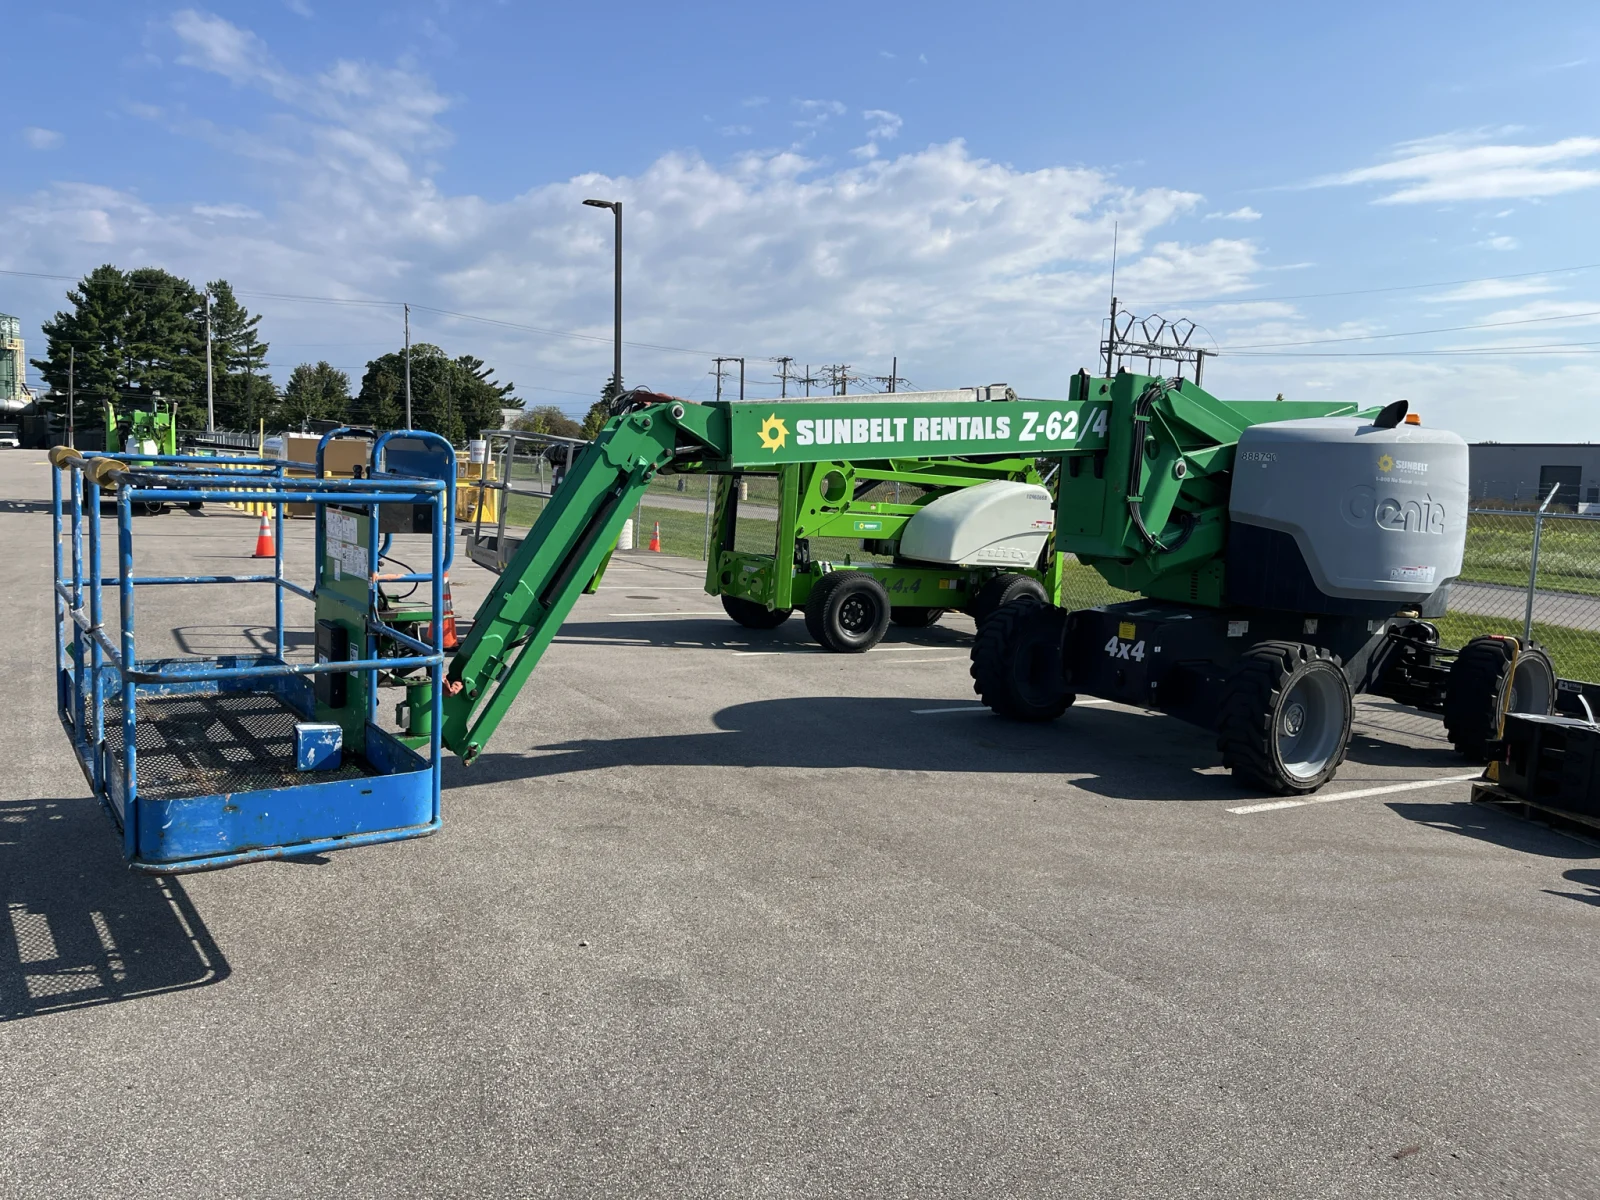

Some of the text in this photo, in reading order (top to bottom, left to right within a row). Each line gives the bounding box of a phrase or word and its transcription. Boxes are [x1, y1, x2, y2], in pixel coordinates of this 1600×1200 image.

[796, 407, 1109, 446] SUNBELT RENTALS Z-62/4
[1395, 460, 1429, 472] SUNBELT
[1104, 636, 1146, 662] 4x4
